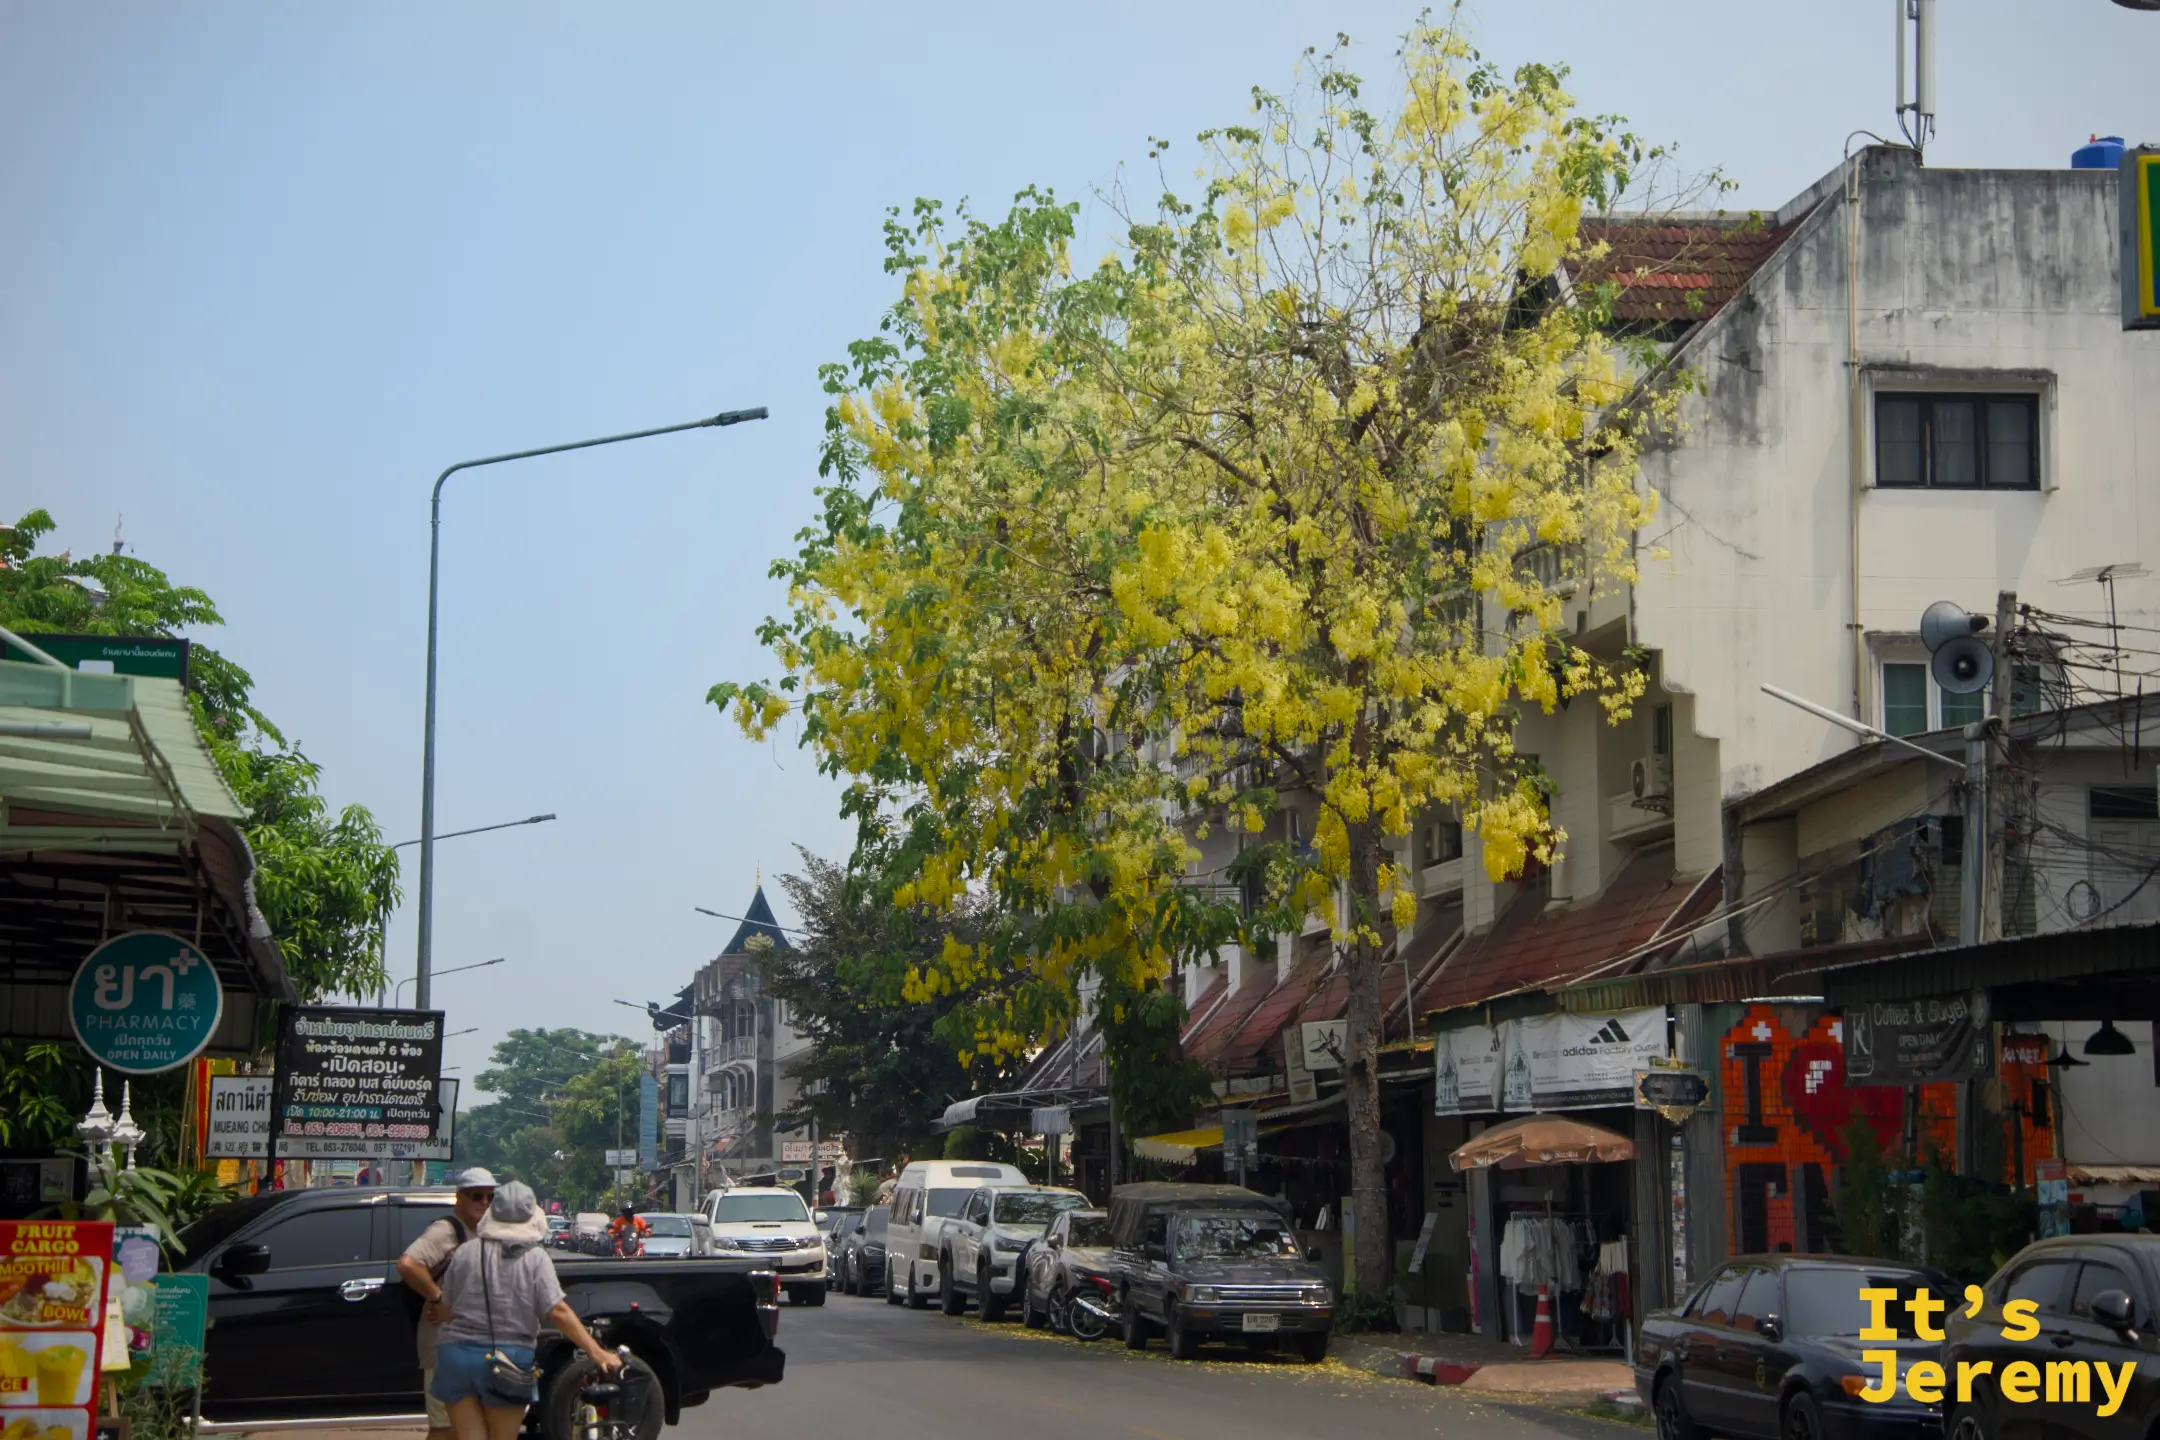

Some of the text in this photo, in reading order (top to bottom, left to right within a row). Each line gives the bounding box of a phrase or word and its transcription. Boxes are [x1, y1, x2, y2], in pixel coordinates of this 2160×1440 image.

[94, 964, 175, 1010] ยา
[1873, 997, 1968, 1027] Coffee & Bagel
[86, 1014, 201, 1031] PHARMACY
[1899, 1034, 1919, 1047] OPEN
[107, 1050, 177, 1061] OPEN DAILY
[389, 1045, 397, 1056] 6
[1562, 1046, 1598, 1057] adidas
[1599, 1045, 1631, 1054] Factory
[1634, 1043, 1660, 1053] Outlet
[308, 1107, 367, 1119] 10:00-21:00
[214, 1120, 249, 1134] MUEANG
[16, 1225, 76, 1239] FRUIT
[10, 1240, 79, 1254] CARGO
[43, 1305, 88, 1321] BOWL
